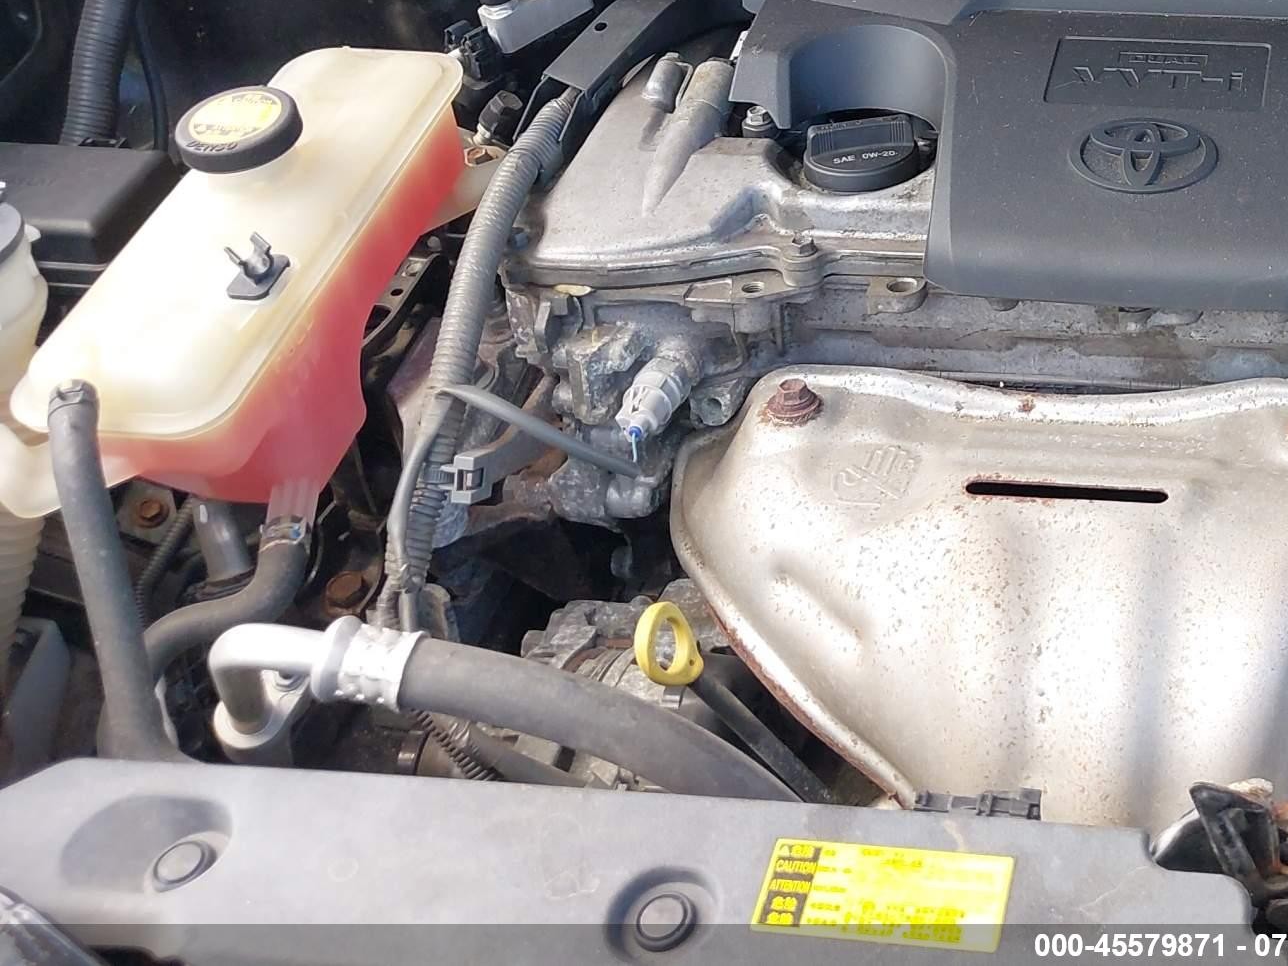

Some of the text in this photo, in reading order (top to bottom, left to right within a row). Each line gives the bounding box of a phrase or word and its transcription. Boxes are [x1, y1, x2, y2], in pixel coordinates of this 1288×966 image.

[185, 140, 239, 152] DENSO
[833, 154, 856, 164] SAE
[776, 859, 818, 875] CAUTION
[768, 878, 812, 894] ATTENTION
